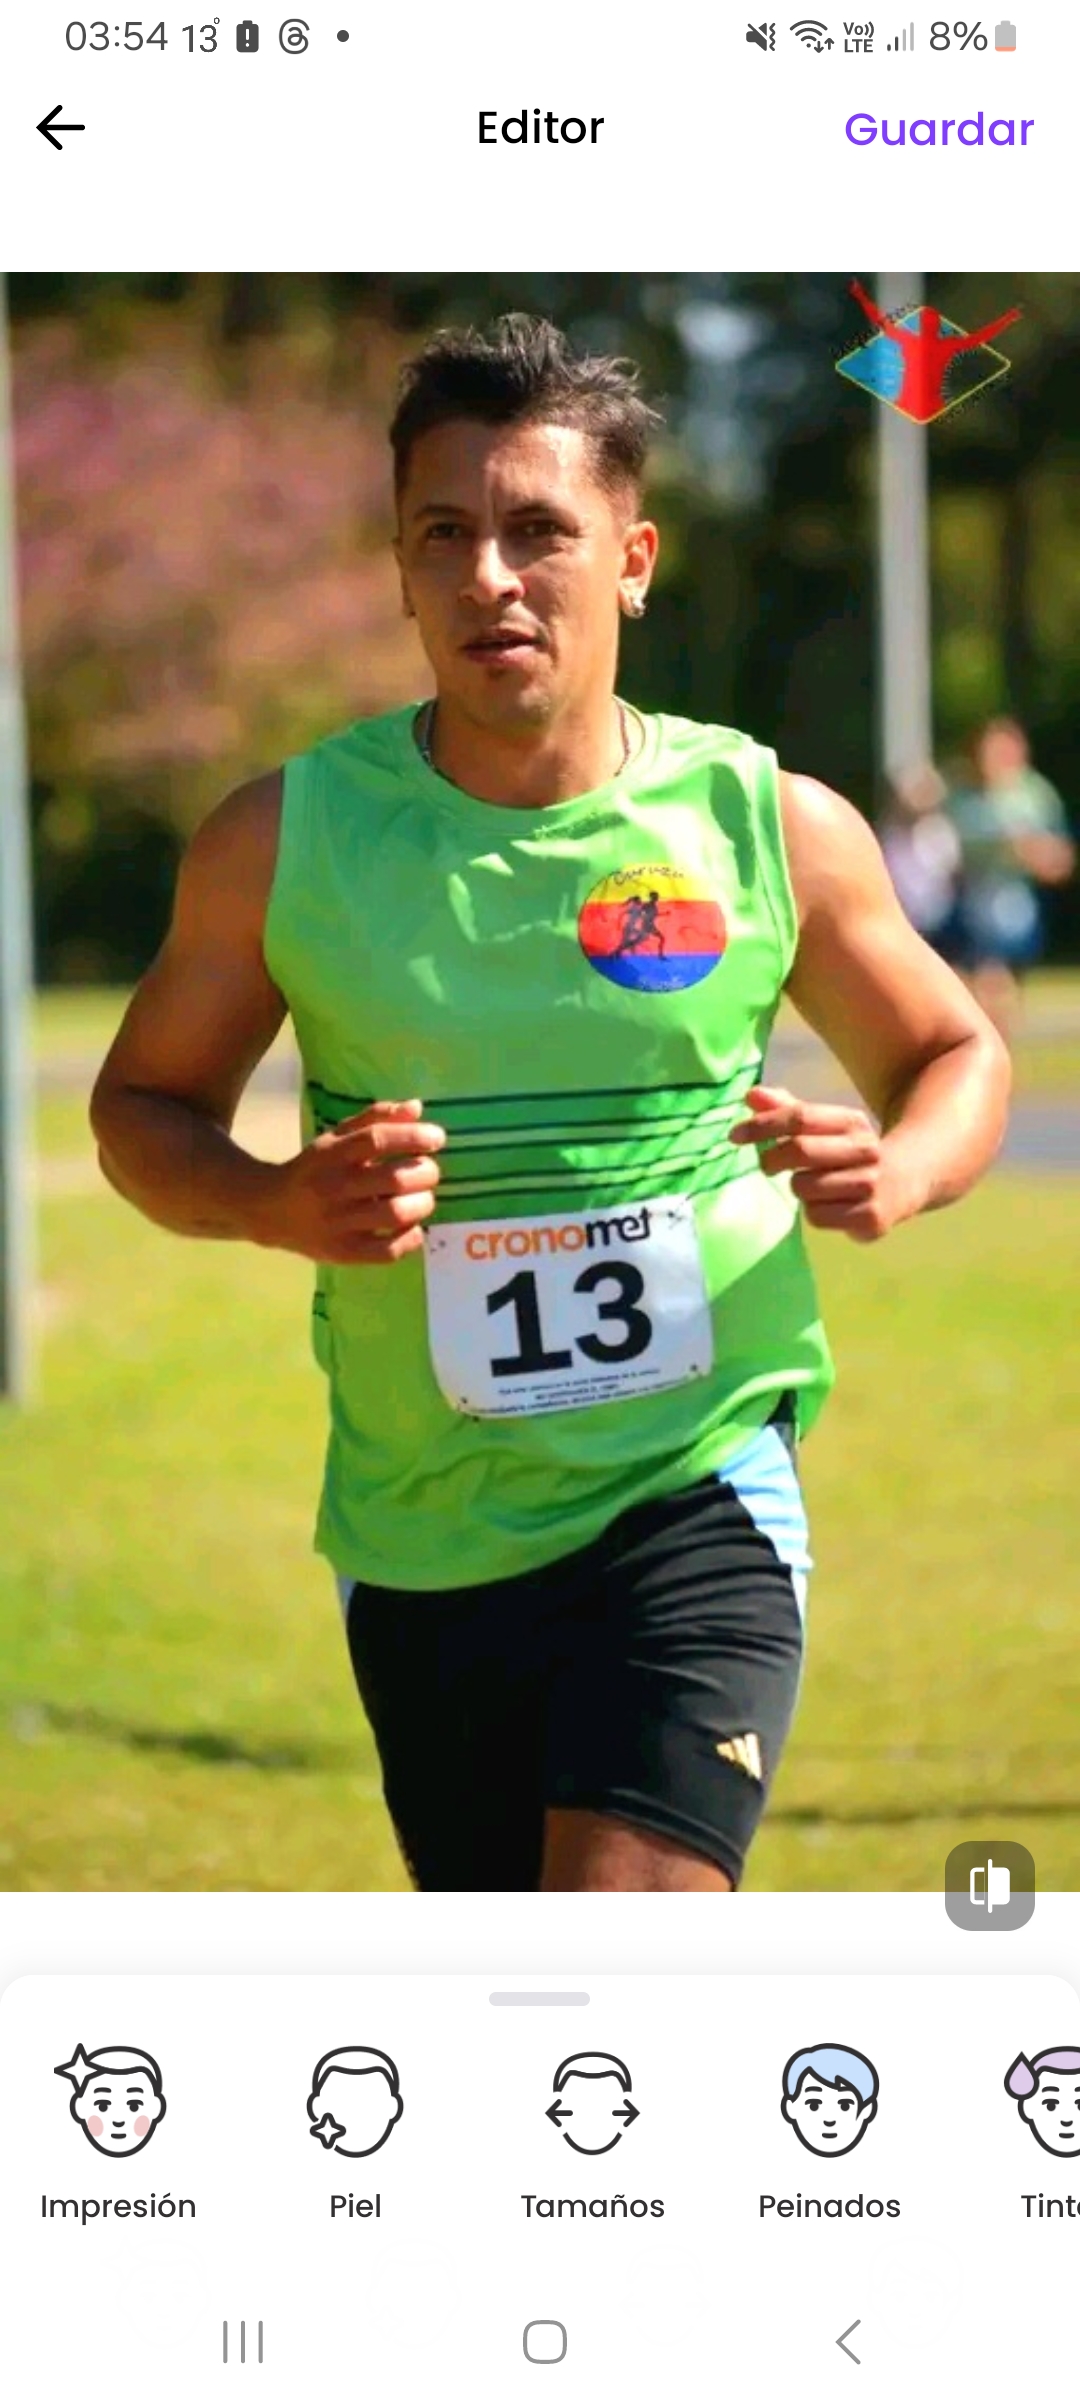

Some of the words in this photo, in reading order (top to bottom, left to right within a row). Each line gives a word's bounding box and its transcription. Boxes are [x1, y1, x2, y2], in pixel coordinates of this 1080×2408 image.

[66, 21, 168, 51] 03:54
[844, 39, 874, 53] LTE
[930, 21, 988, 51] 8%
[479, 108, 604, 144] Editor
[845, 111, 1034, 146] Guardar
[486, 1260, 653, 1378] 13
[41, 2193, 196, 2225] Impresión
[330, 2193, 381, 2218] Piel
[521, 2194, 665, 2218] Tamaños
[759, 2193, 901, 2218] Peinados
